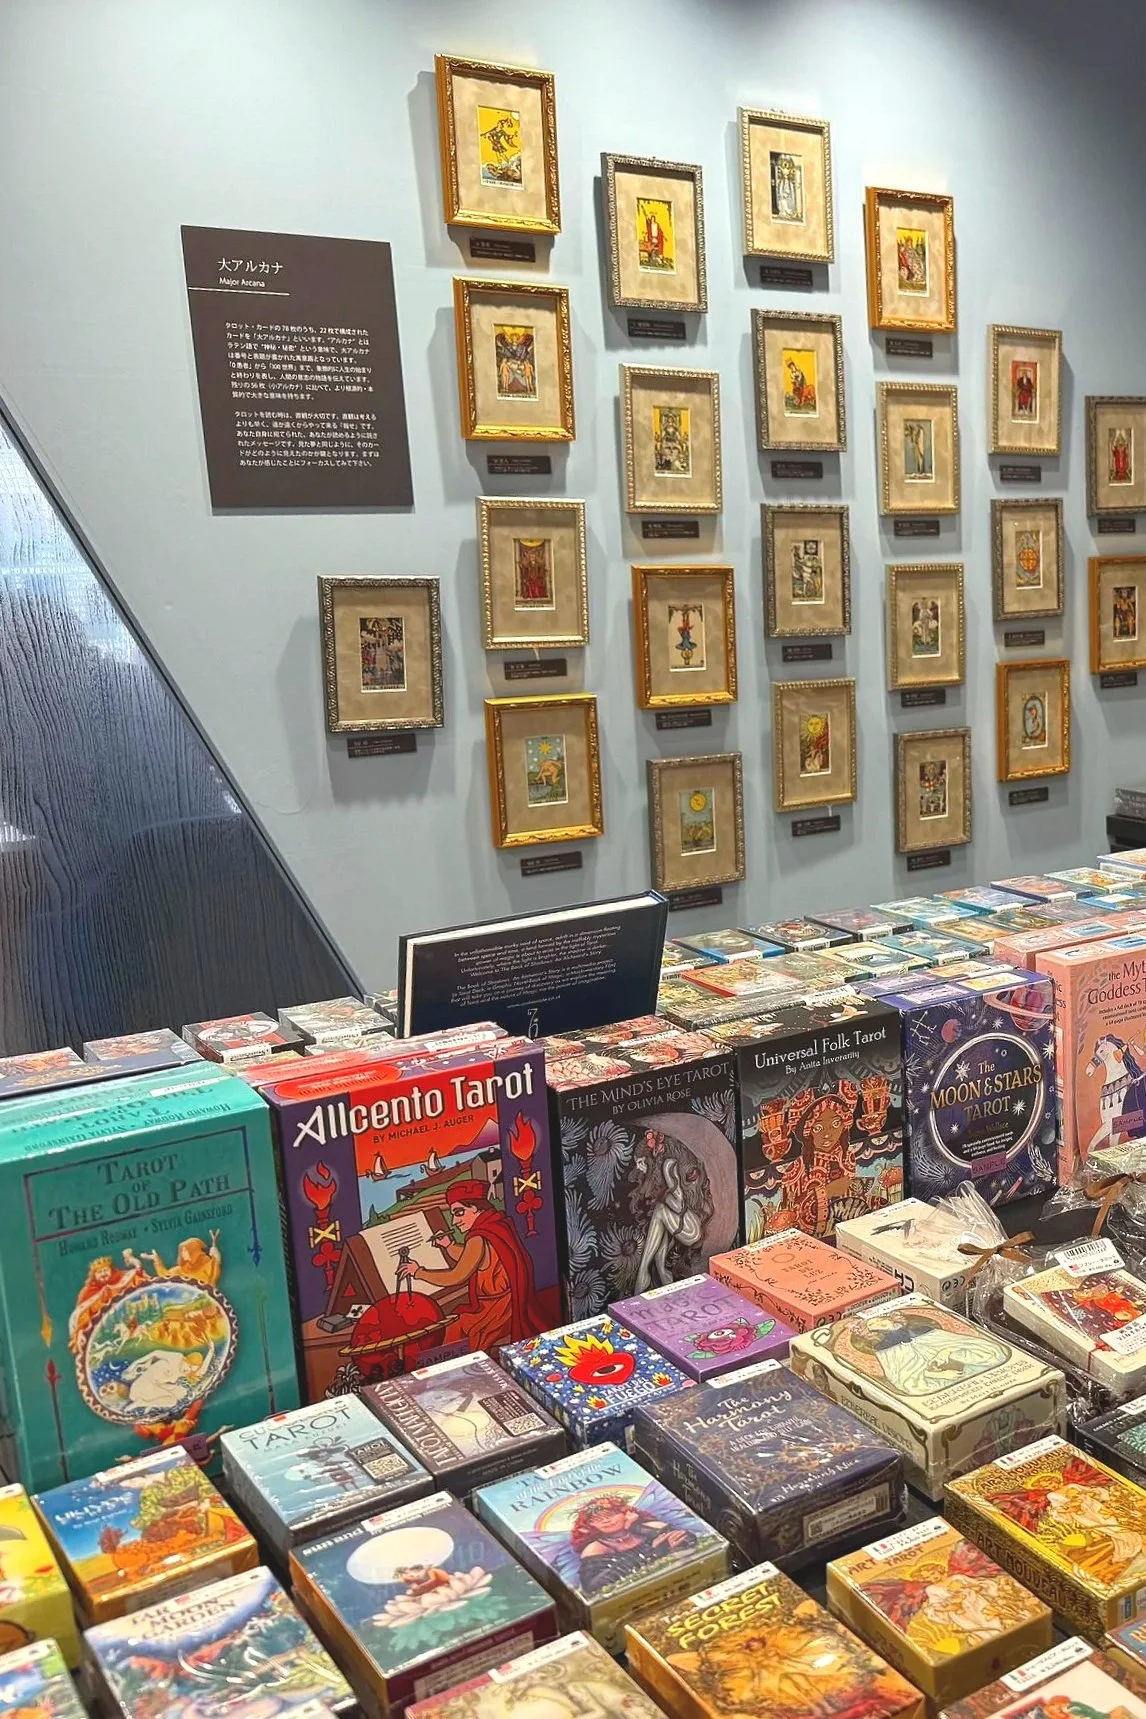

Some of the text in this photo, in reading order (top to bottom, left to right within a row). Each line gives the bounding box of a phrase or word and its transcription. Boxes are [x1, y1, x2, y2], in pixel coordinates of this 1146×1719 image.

[217, 258, 284, 274] 大アルカナ
[220, 277, 265, 288] Major Arcana
[1108, 971, 1120, 981] the
[1088, 981, 1141, 1005] Goddess
[755, 1027, 886, 1071] Universal Folk Tarot
[785, 1064, 797, 1076] By
[799, 1058, 821, 1071] Anita
[978, 1062, 995, 1074] The
[567, 1062, 729, 1112] THE MIND'S EYE TAROT
[930, 1065, 1042, 1110] MOON & STARS
[292, 1062, 535, 1149] Allcento Tarot
[612, 1087, 691, 1115] BY OLIVIA ROSE
[964, 1096, 1010, 1120] TAROT
[372, 1113, 474, 1144] BY MICHAEL J. AUGER
[1113, 1116, 1143, 1128] SAMPLE
[97, 1154, 177, 1185] TAROT
[973, 1158, 1006, 1172] SAMPLE
[132, 1182, 150, 1193] OF
[50, 1173, 230, 1230] THE OLD PATH
[58, 1237, 98, 1257] HOWARD
[151, 1218, 181, 1234] SYLVIA
[185, 1204, 233, 1224] GAINSFORD
[646, 1299, 736, 1332] TAROT
[601, 1377, 649, 1396] TAROT DEL
[608, 1382, 655, 1403] FUEGO
[684, 1390, 792, 1433] Harmony
[718, 1406, 786, 1432] Tarot
[245, 1407, 352, 1450] TAROT
[509, 1464, 623, 1513] RAINBOW
[884, 1546, 924, 1567] TAROT
[976, 1536, 1000, 1554] ART
[847, 1558, 876, 1576] ART
[142, 1600, 236, 1640] GARDEN
[150, 1599, 219, 1626] MOON
[668, 1582, 770, 1637] SECRET
[679, 1593, 783, 1649] FOREST
